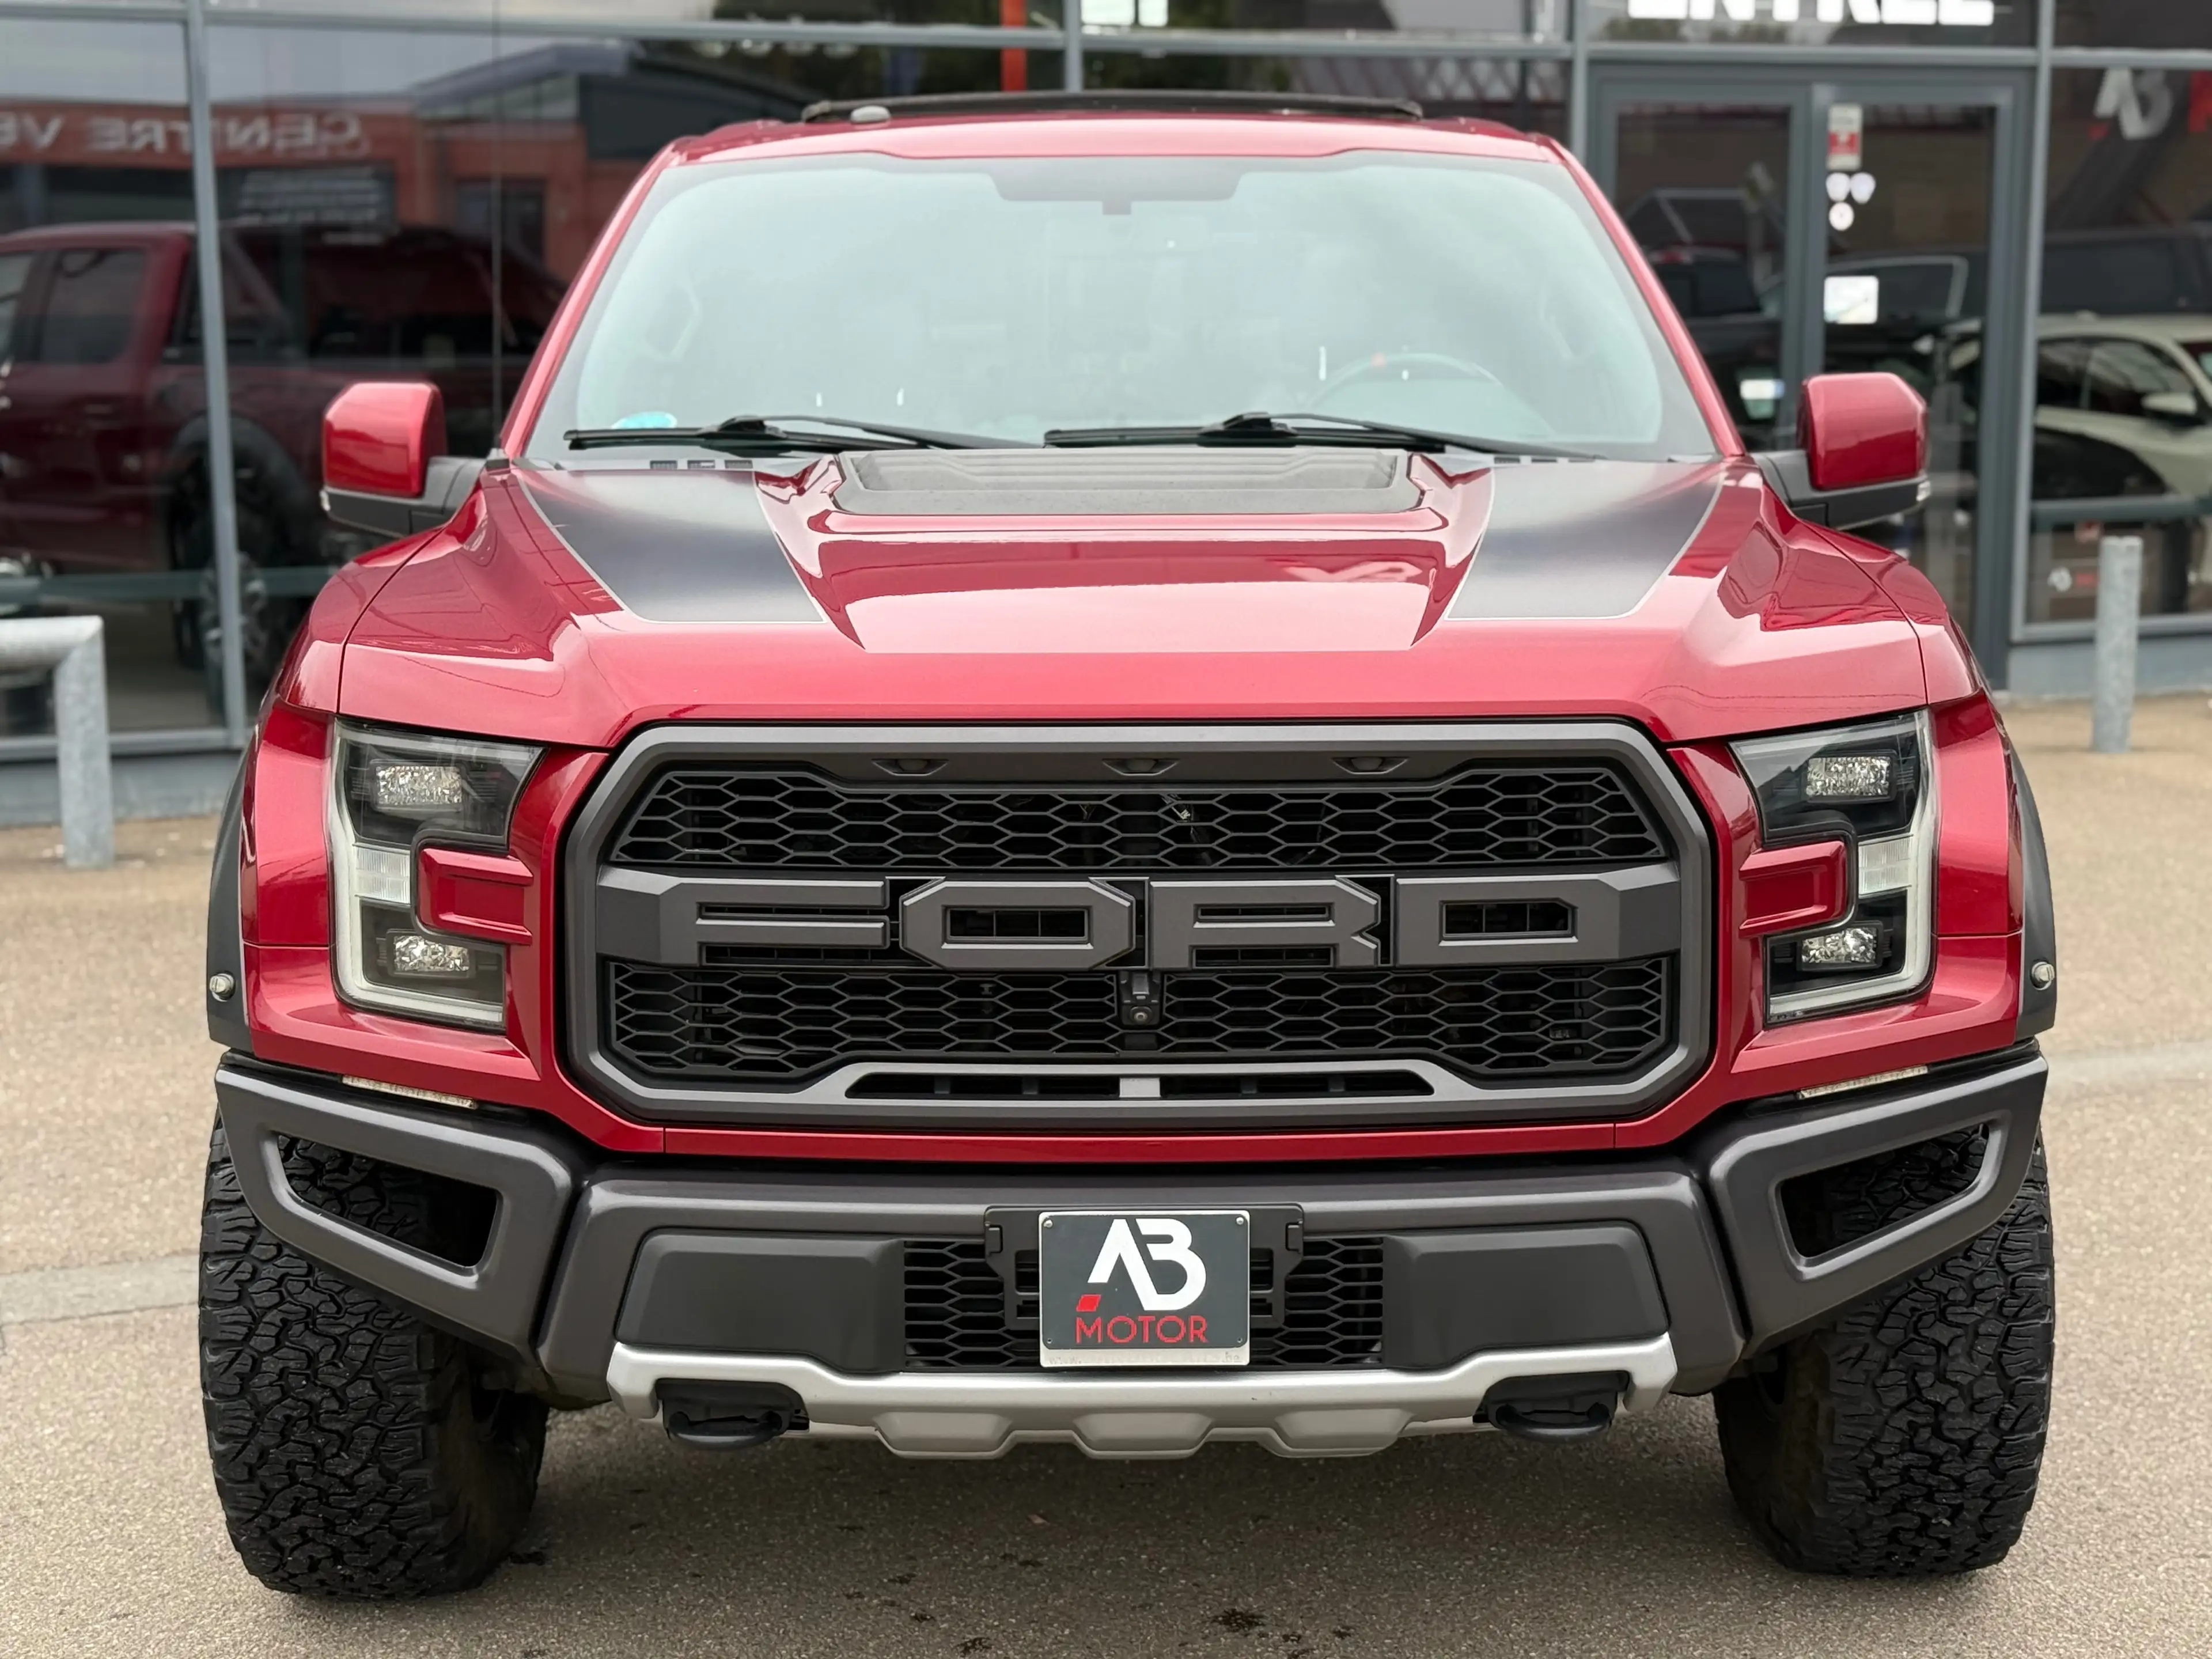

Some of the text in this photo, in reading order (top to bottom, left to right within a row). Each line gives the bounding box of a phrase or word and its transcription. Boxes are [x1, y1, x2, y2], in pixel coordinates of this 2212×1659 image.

[595, 863, 1680, 969] FORD
[1088, 1218, 1206, 1310] AB
[1075, 1315, 1208, 1343] MOTOR
